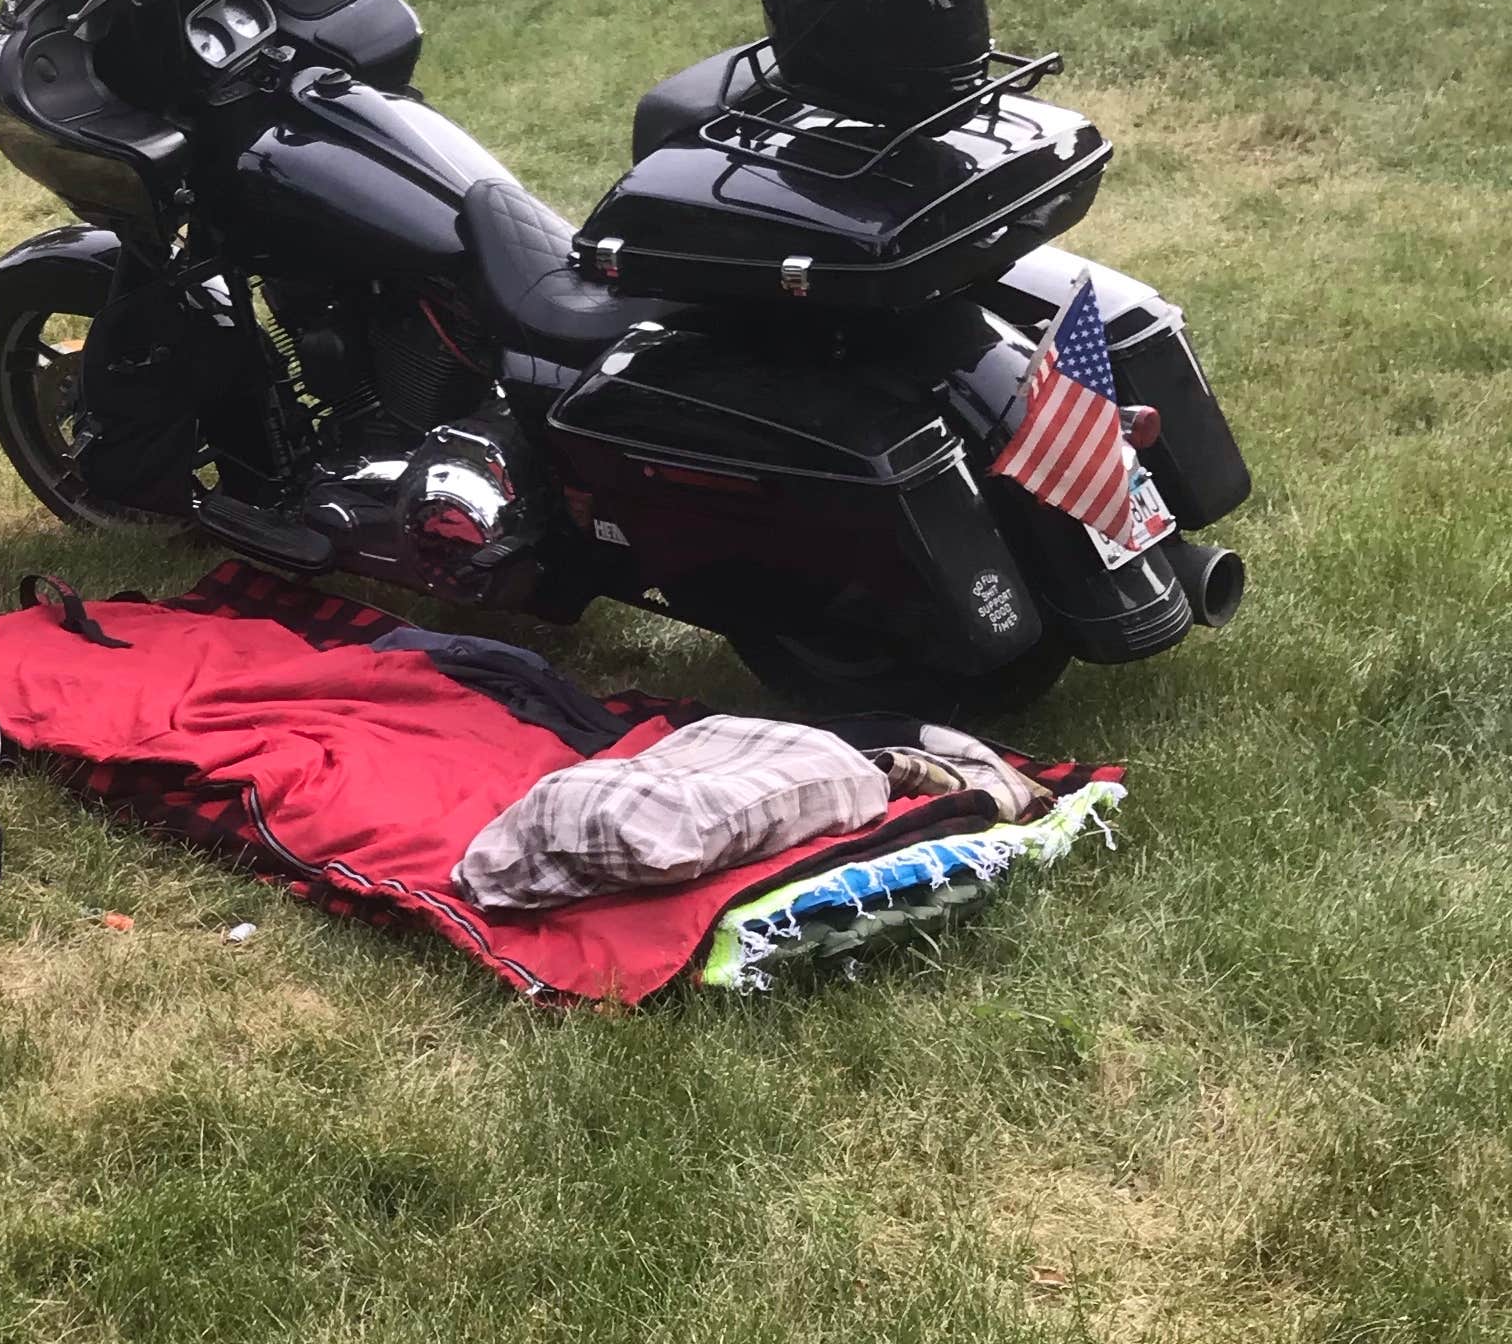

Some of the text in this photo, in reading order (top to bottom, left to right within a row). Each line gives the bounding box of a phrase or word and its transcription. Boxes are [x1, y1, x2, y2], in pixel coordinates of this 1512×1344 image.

[973, 574, 999, 597] DO FUN
[981, 584, 999, 602] SHIT
[978, 588, 1013, 618] SUPPORT
[989, 603, 1012, 623] GOOD
[992, 612, 1018, 633] TIMES
